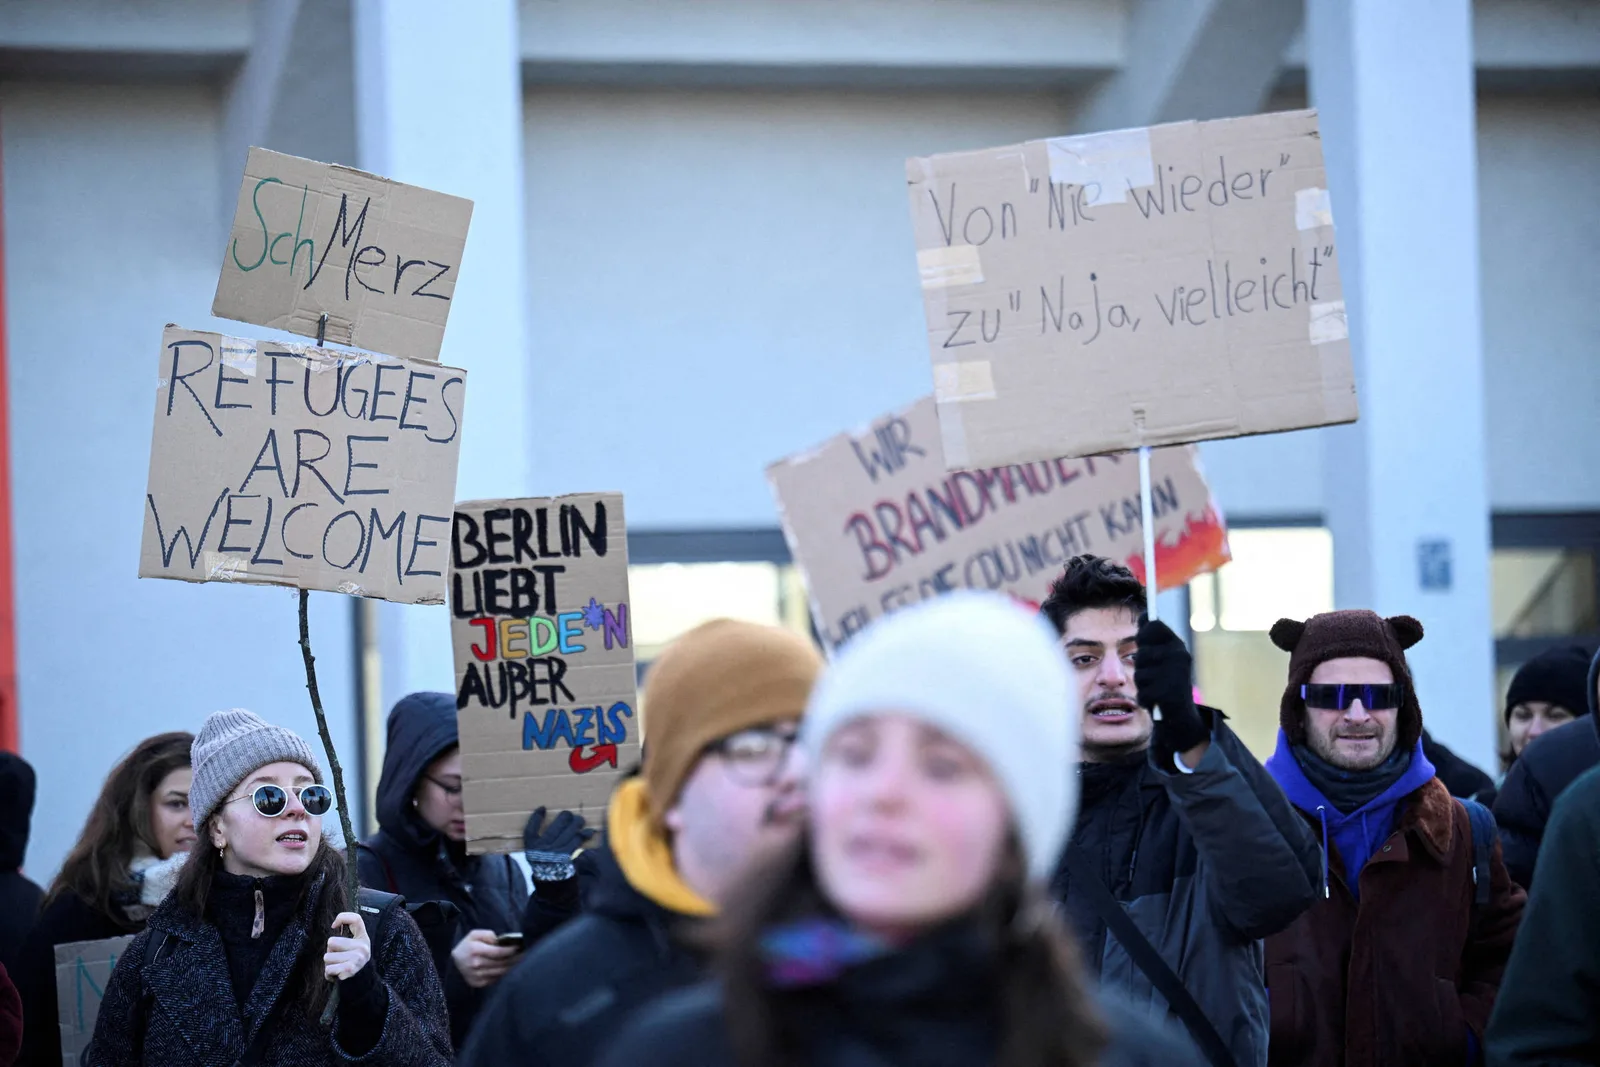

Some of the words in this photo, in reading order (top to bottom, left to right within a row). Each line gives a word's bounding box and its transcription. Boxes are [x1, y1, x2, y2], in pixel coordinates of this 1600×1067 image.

[929, 182, 1017, 247] Von
[167, 340, 463, 443] REFUGEES
[239, 428, 389, 505] ARE
[848, 414, 926, 483] WIR
[147, 487, 450, 585] WELCOME
[452, 501, 608, 569] BERLIN
[453, 565, 566, 618] LIEBT
[522, 701, 633, 750] NAZIS
